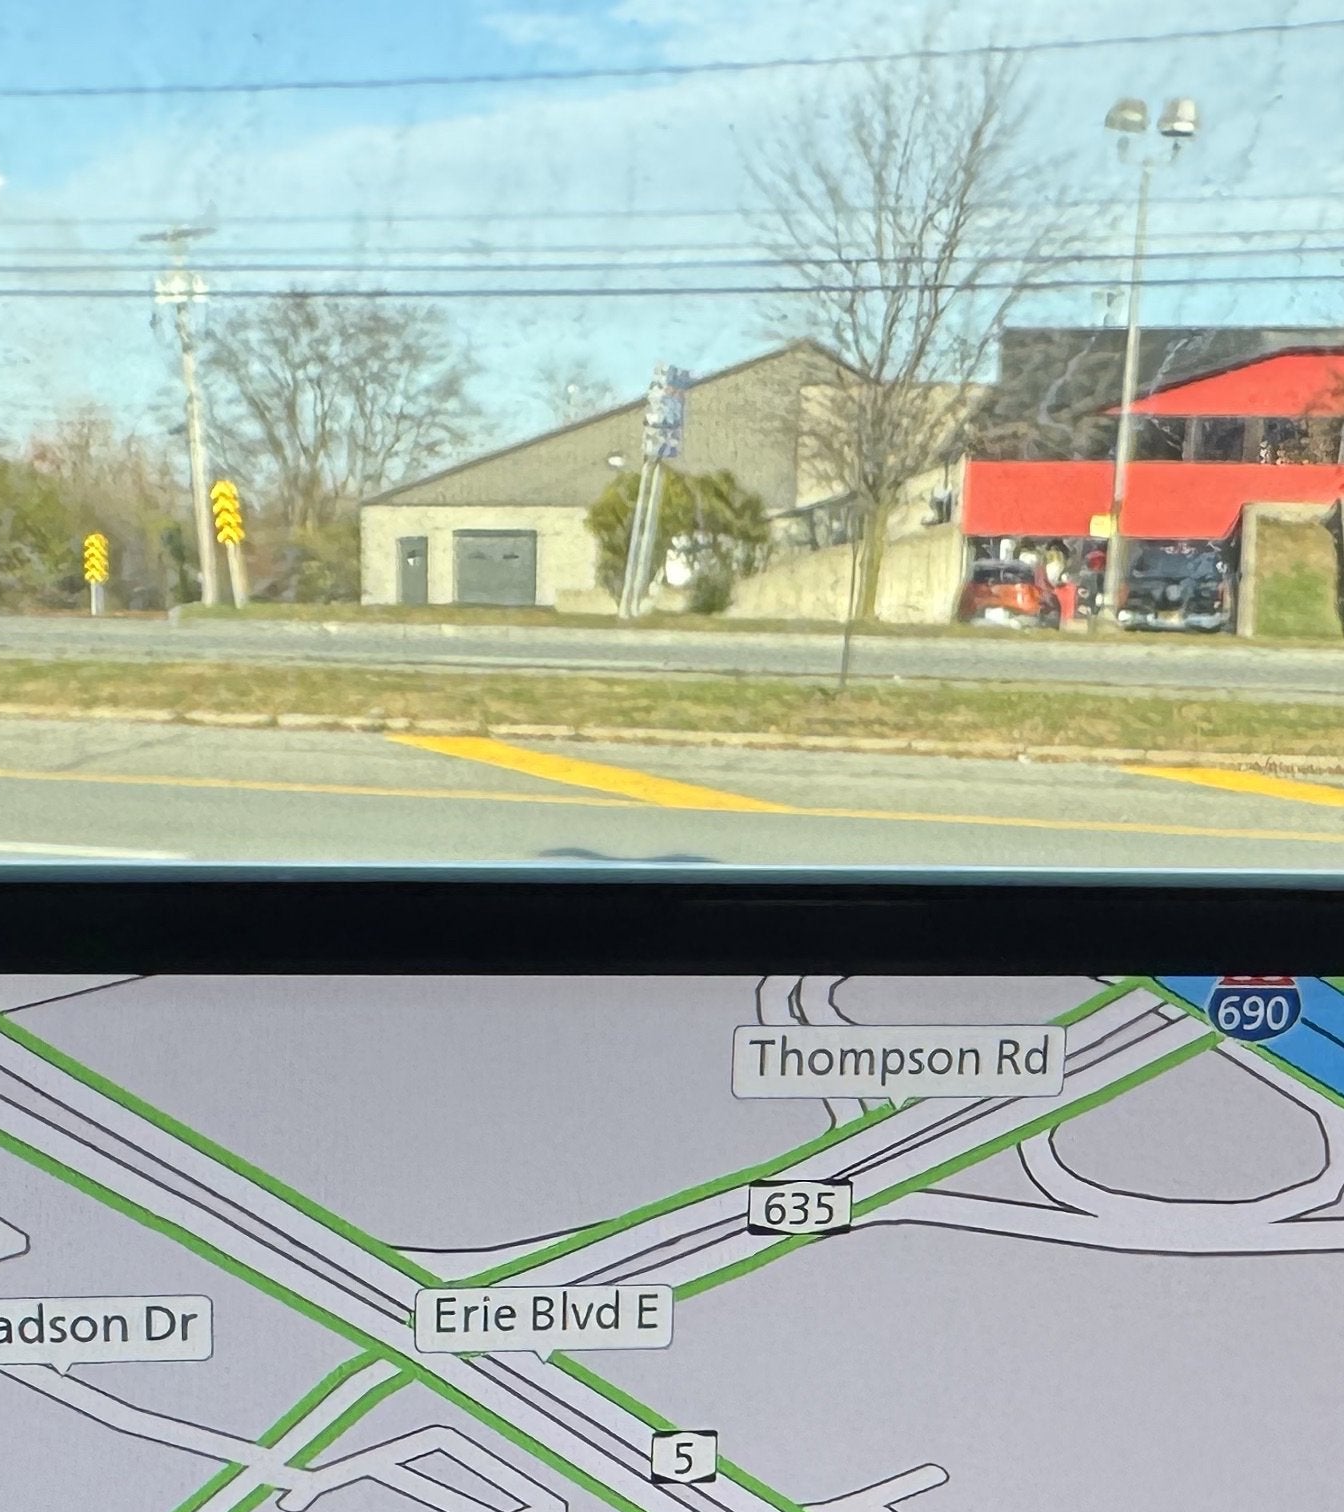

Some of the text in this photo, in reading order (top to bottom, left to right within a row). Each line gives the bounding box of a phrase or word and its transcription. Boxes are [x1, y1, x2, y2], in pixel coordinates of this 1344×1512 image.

[1218, 994, 1290, 1031] 690
[748, 1034, 1049, 1087] Thompson Rd
[764, 1191, 835, 1224] 635
[145, 1305, 198, 1342] Dr
[436, 1289, 659, 1333] Erie Blvd E
[676, 1442, 694, 1474] 5
